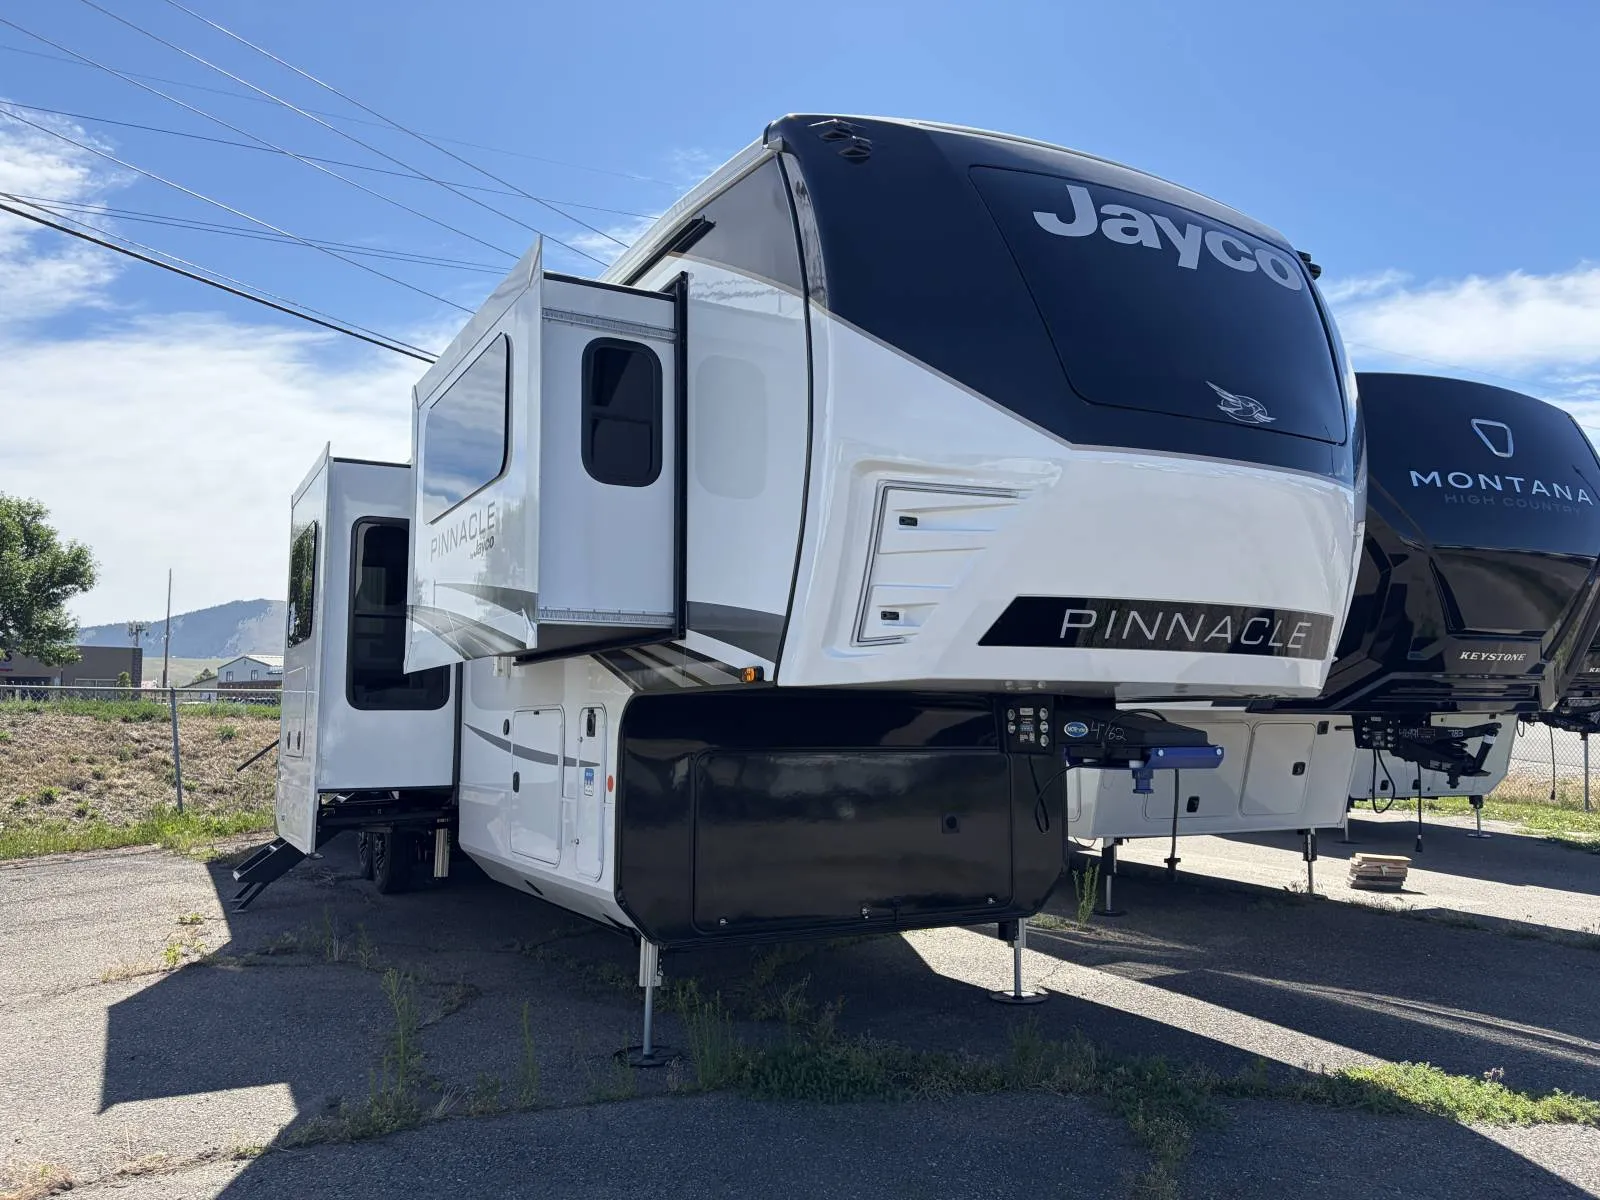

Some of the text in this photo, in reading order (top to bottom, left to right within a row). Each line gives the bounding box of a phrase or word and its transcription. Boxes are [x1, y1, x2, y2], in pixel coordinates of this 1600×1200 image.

[1032, 184, 1302, 291] Jayco
[1409, 470, 1594, 506] MONTANA
[1444, 492, 1582, 516] HIGH COUNTRY
[430, 501, 496, 563] PINNACLE
[1059, 608, 1313, 649] PINNACLE
[1459, 650, 1527, 662] KEYSTONE
